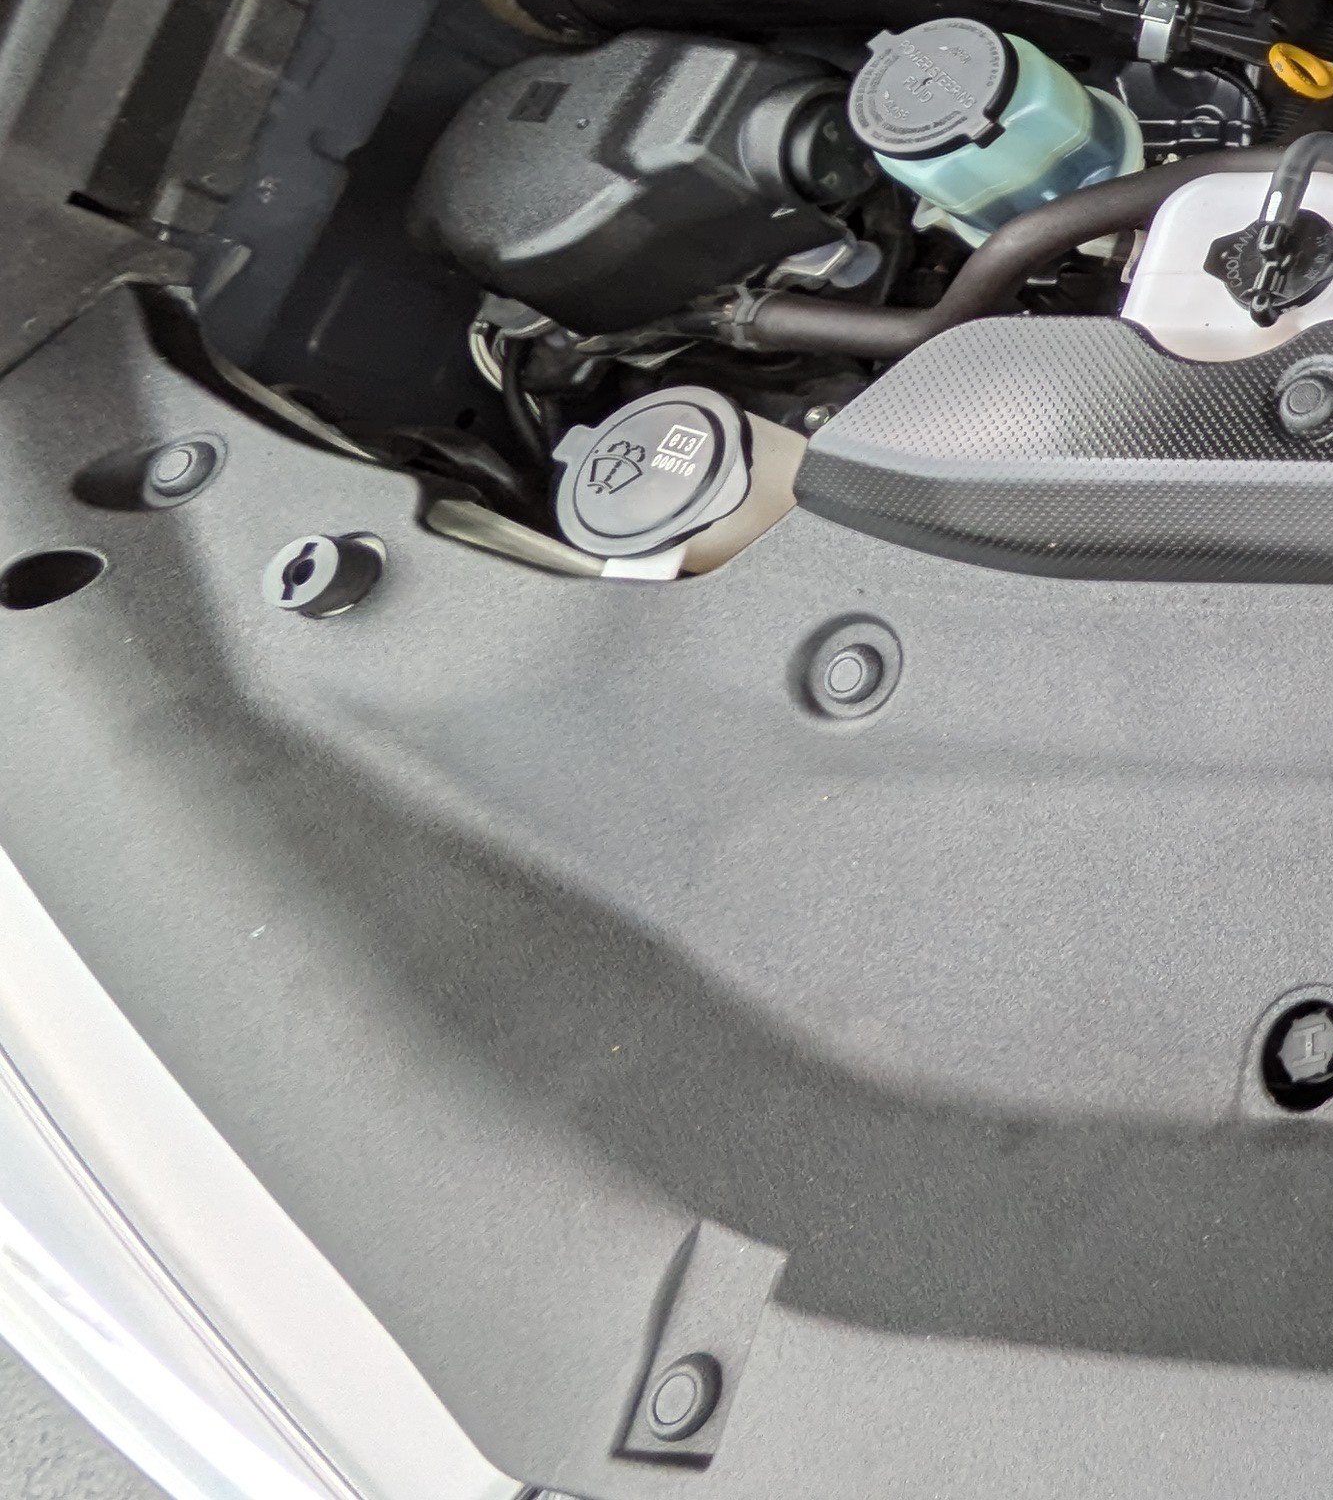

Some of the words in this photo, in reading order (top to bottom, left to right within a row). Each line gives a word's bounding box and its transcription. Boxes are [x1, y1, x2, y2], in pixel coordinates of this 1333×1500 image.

[927, 66, 977, 110] STEERING
[1225, 223, 1260, 288] COOLANT
[668, 433, 698, 452] e13
[650, 453, 696, 477] 000116
